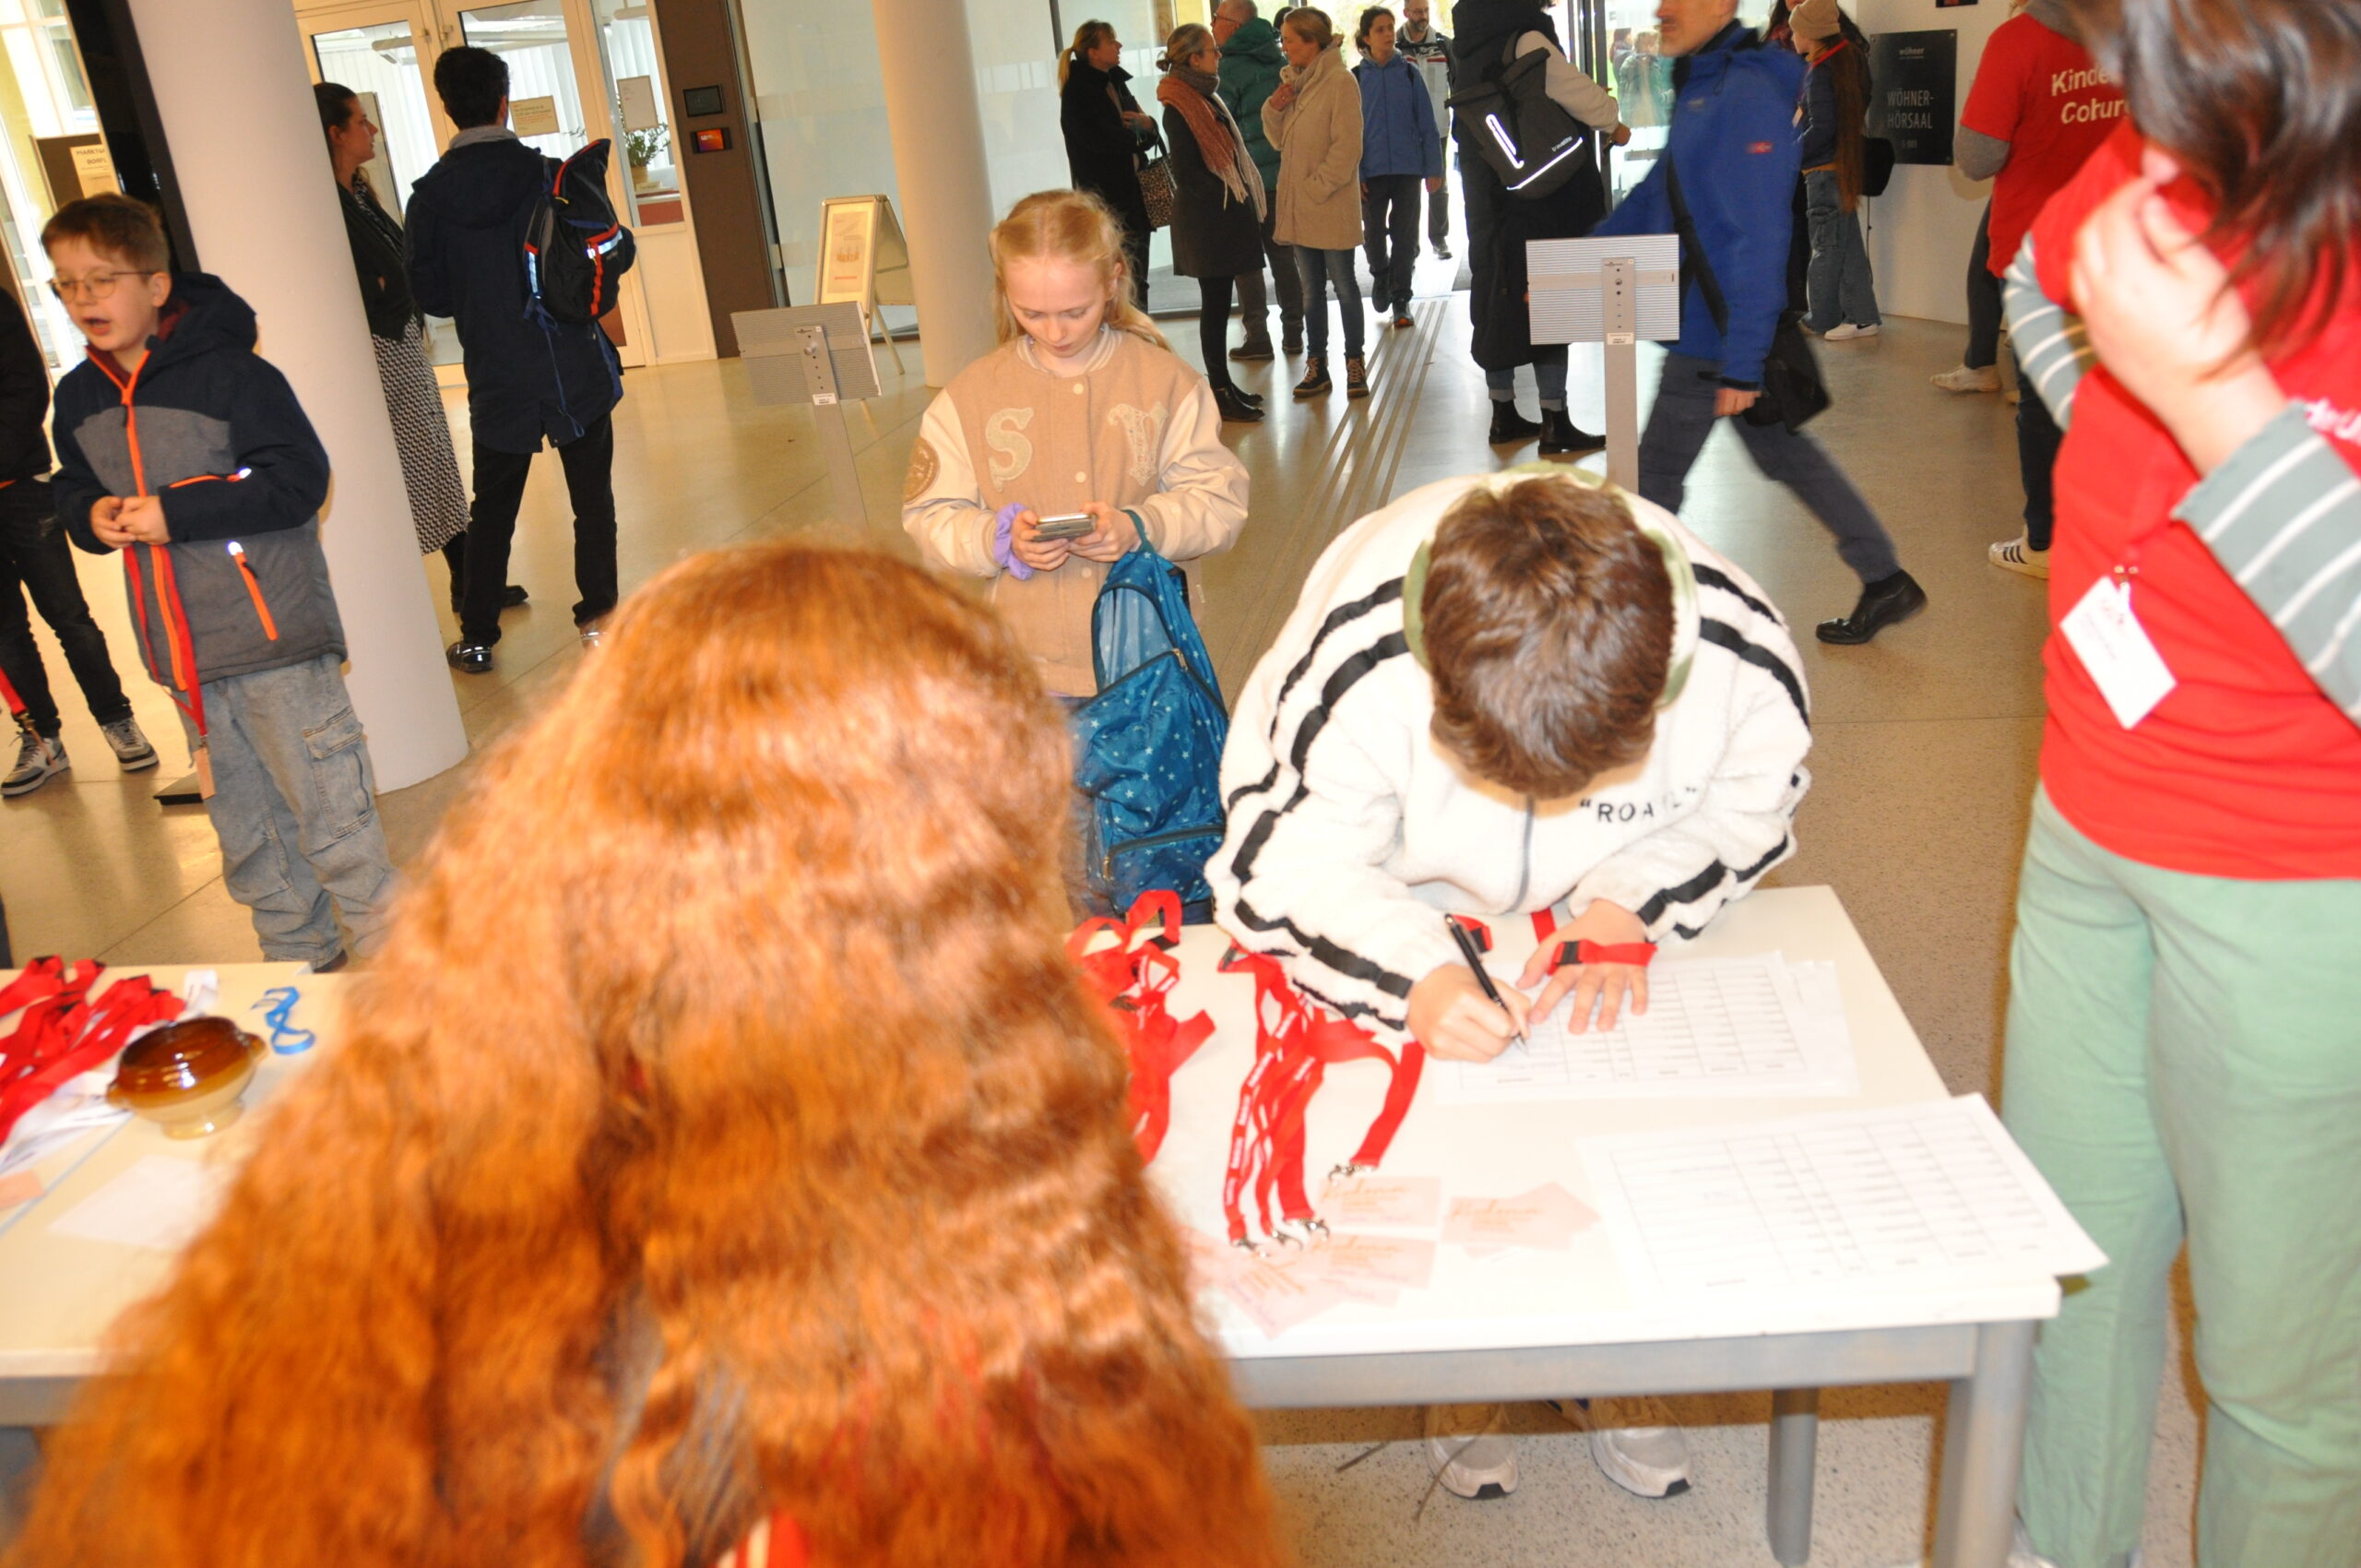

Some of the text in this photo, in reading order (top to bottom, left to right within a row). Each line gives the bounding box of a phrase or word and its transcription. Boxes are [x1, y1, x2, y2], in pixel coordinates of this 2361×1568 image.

[1887, 88, 1934, 107] WÖHNER-
[1888, 110, 1933, 129] HÖRSAAL
[985, 407, 1034, 493] S
